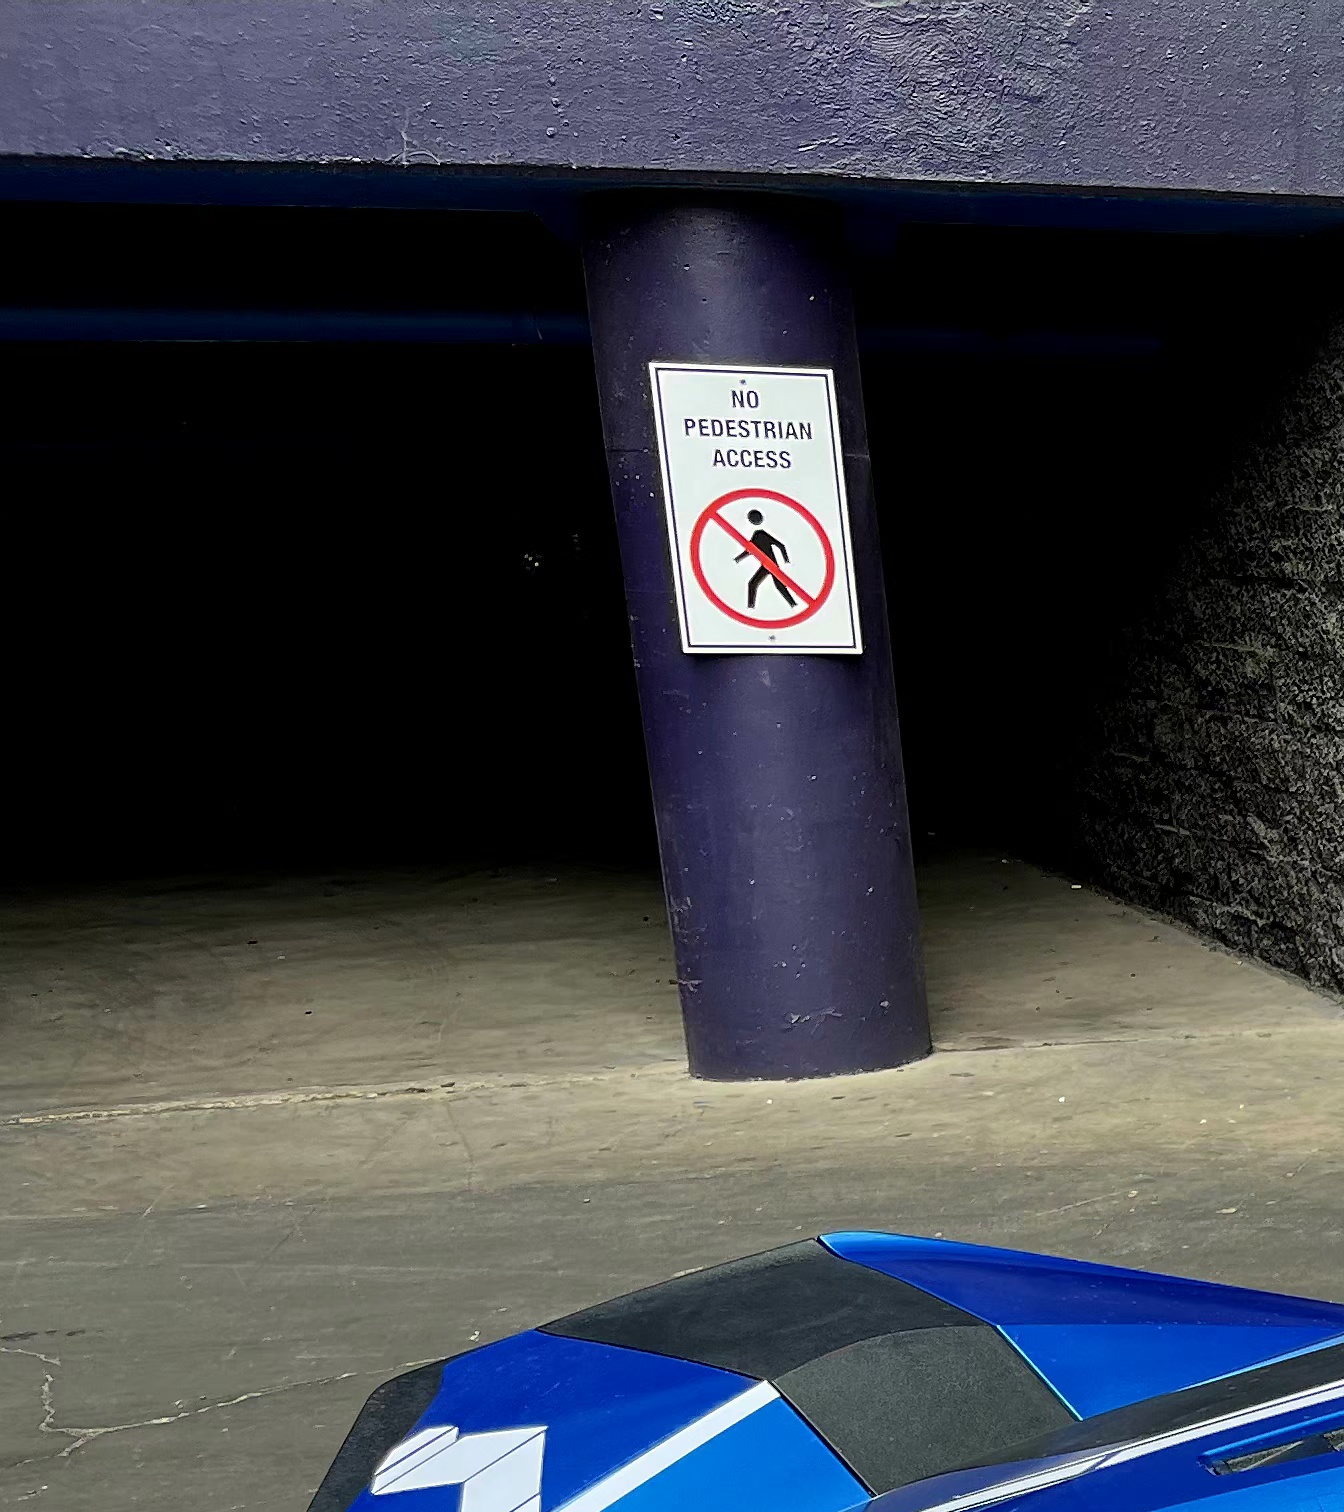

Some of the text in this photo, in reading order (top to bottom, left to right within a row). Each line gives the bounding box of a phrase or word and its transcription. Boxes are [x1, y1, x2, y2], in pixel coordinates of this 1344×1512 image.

[731, 390, 759, 408] NO
[684, 418, 813, 440] PEDESTRIAN
[712, 449, 792, 469] ACCESS
